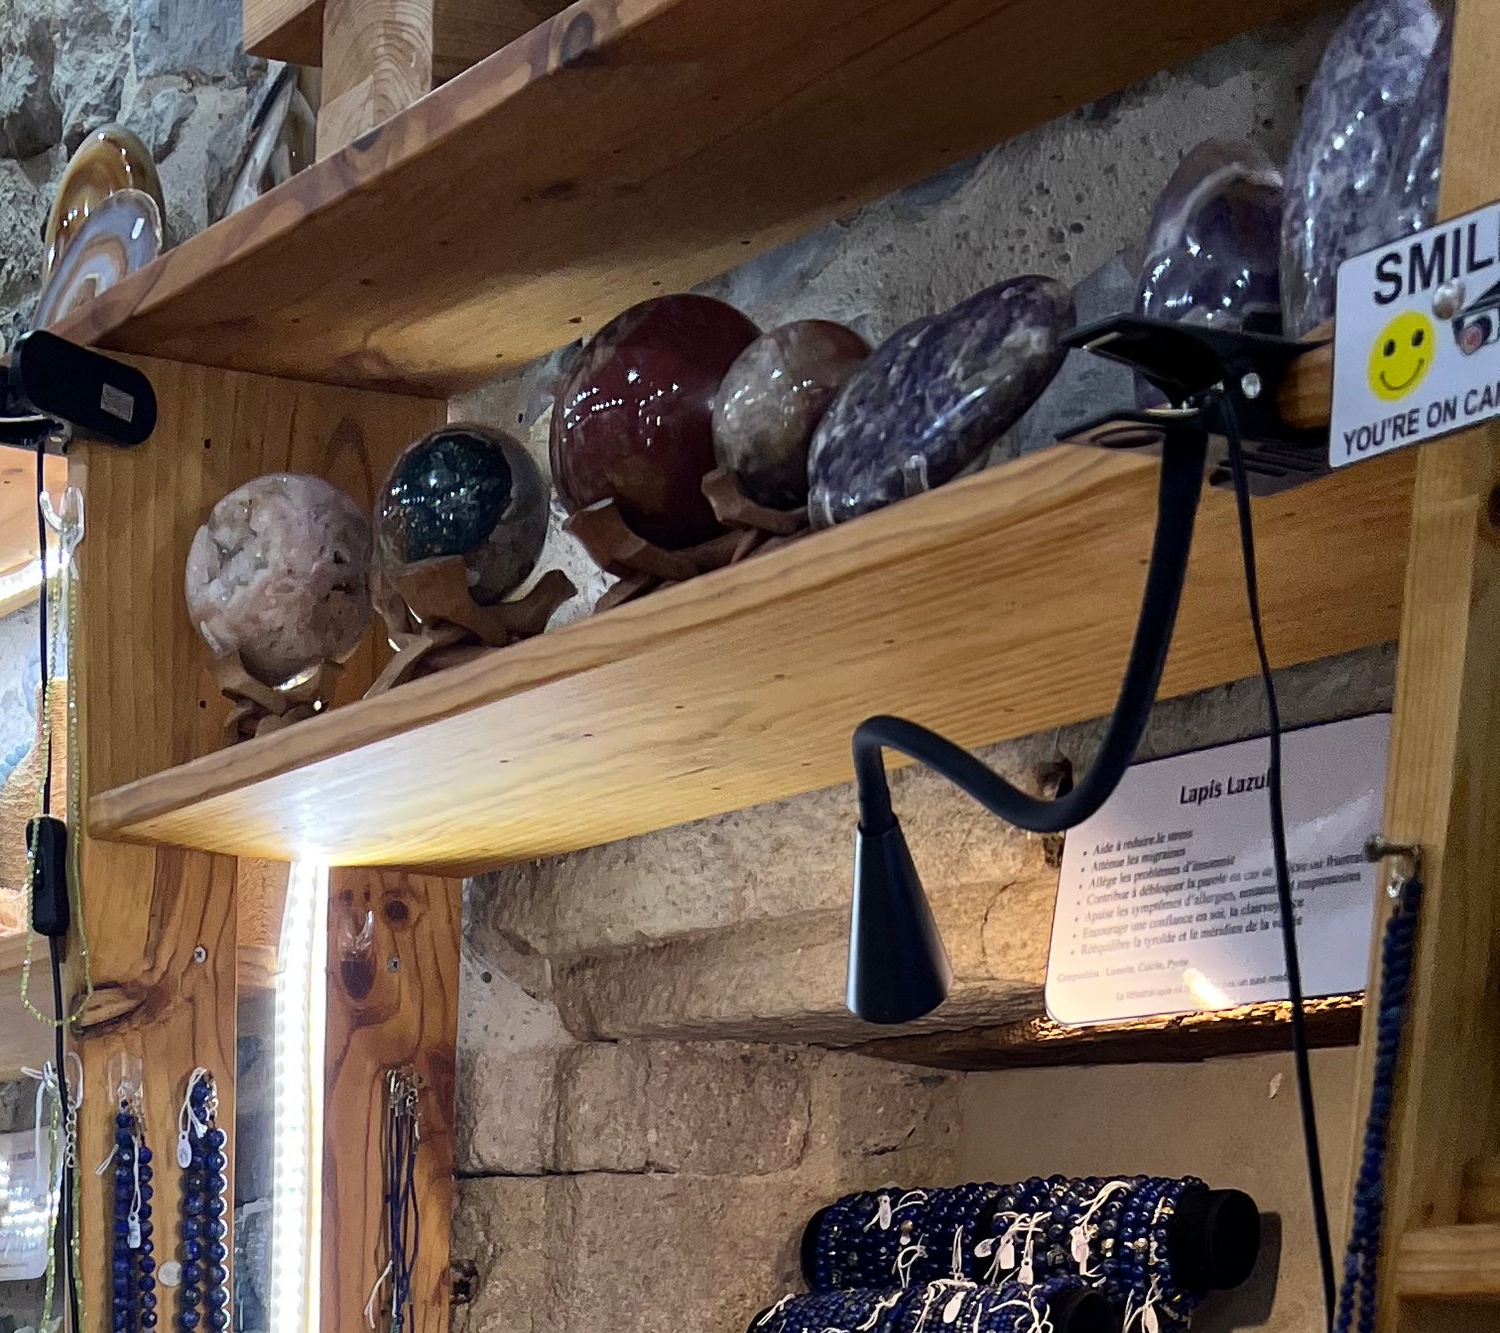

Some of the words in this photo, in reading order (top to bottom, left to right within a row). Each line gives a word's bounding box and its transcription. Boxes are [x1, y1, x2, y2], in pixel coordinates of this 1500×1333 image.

[1374, 212, 1500, 305] SMIL
[1344, 408, 1420, 456] YOU'RE
[1427, 397, 1456, 428] ON
[1179, 775, 1222, 805] Lapis
[1227, 768, 1274, 797] Lazul
[1093, 842, 1113, 856] Aide
[1091, 858, 1124, 872] Atténue
[1127, 854, 1139, 864] les
[1089, 875, 1117, 890] Allège
[1119, 872, 1131, 882] les
[1087, 892, 1129, 906] Contribue
[1139, 881, 1184, 897] débloquer
[1187, 878, 1195, 889] la
[1117, 907, 1128, 917] les
[1149, 911, 1193, 928] confiance
[1134, 937, 1141, 947] la
[1189, 929, 1198, 940] le
